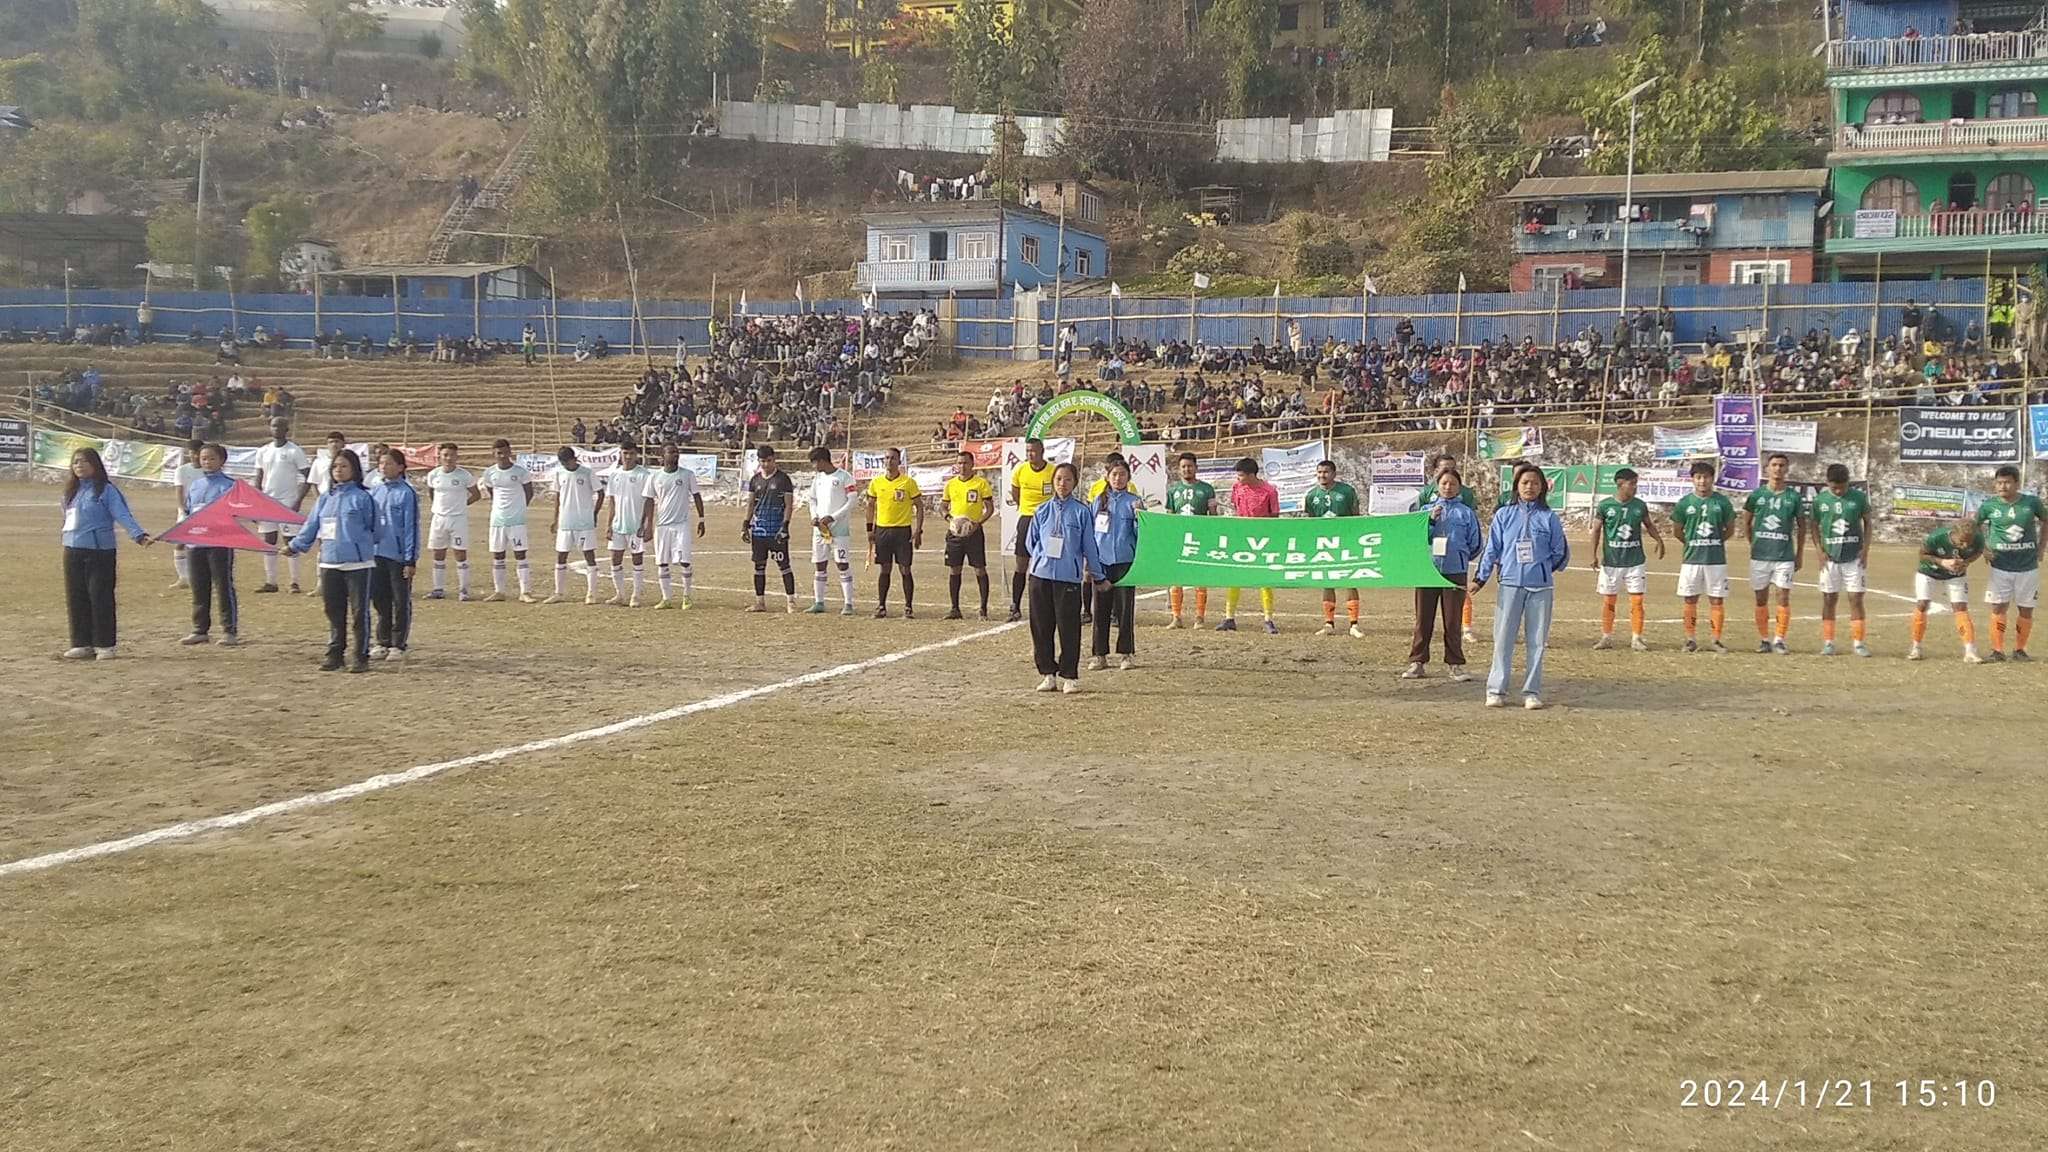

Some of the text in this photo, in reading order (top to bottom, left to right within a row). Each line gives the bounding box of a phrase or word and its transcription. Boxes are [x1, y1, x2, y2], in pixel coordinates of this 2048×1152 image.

[1722, 414, 1748, 424] TVS
[1920, 410, 2006, 421] WELCOME TO ILAM
[1722, 446, 1748, 456] TVS
[1722, 477, 1747, 488] TVS
[1182, 489, 1194, 500] 13
[1325, 495, 1331, 506] 3
[1769, 498, 1781, 510] 14
[1622, 508, 1629, 519] 7
[1701, 504, 1708, 517] 2
[1834, 502, 1842, 514] 8
[2008, 507, 2016, 519] 4
[1184, 532, 1383, 551] LIVING
[1755, 531, 1789, 541] SUZUKI
[1996, 542, 2036, 550] SUZUKI
[837, 549, 846, 559] 12
[1284, 567, 1383, 580] FIFA
